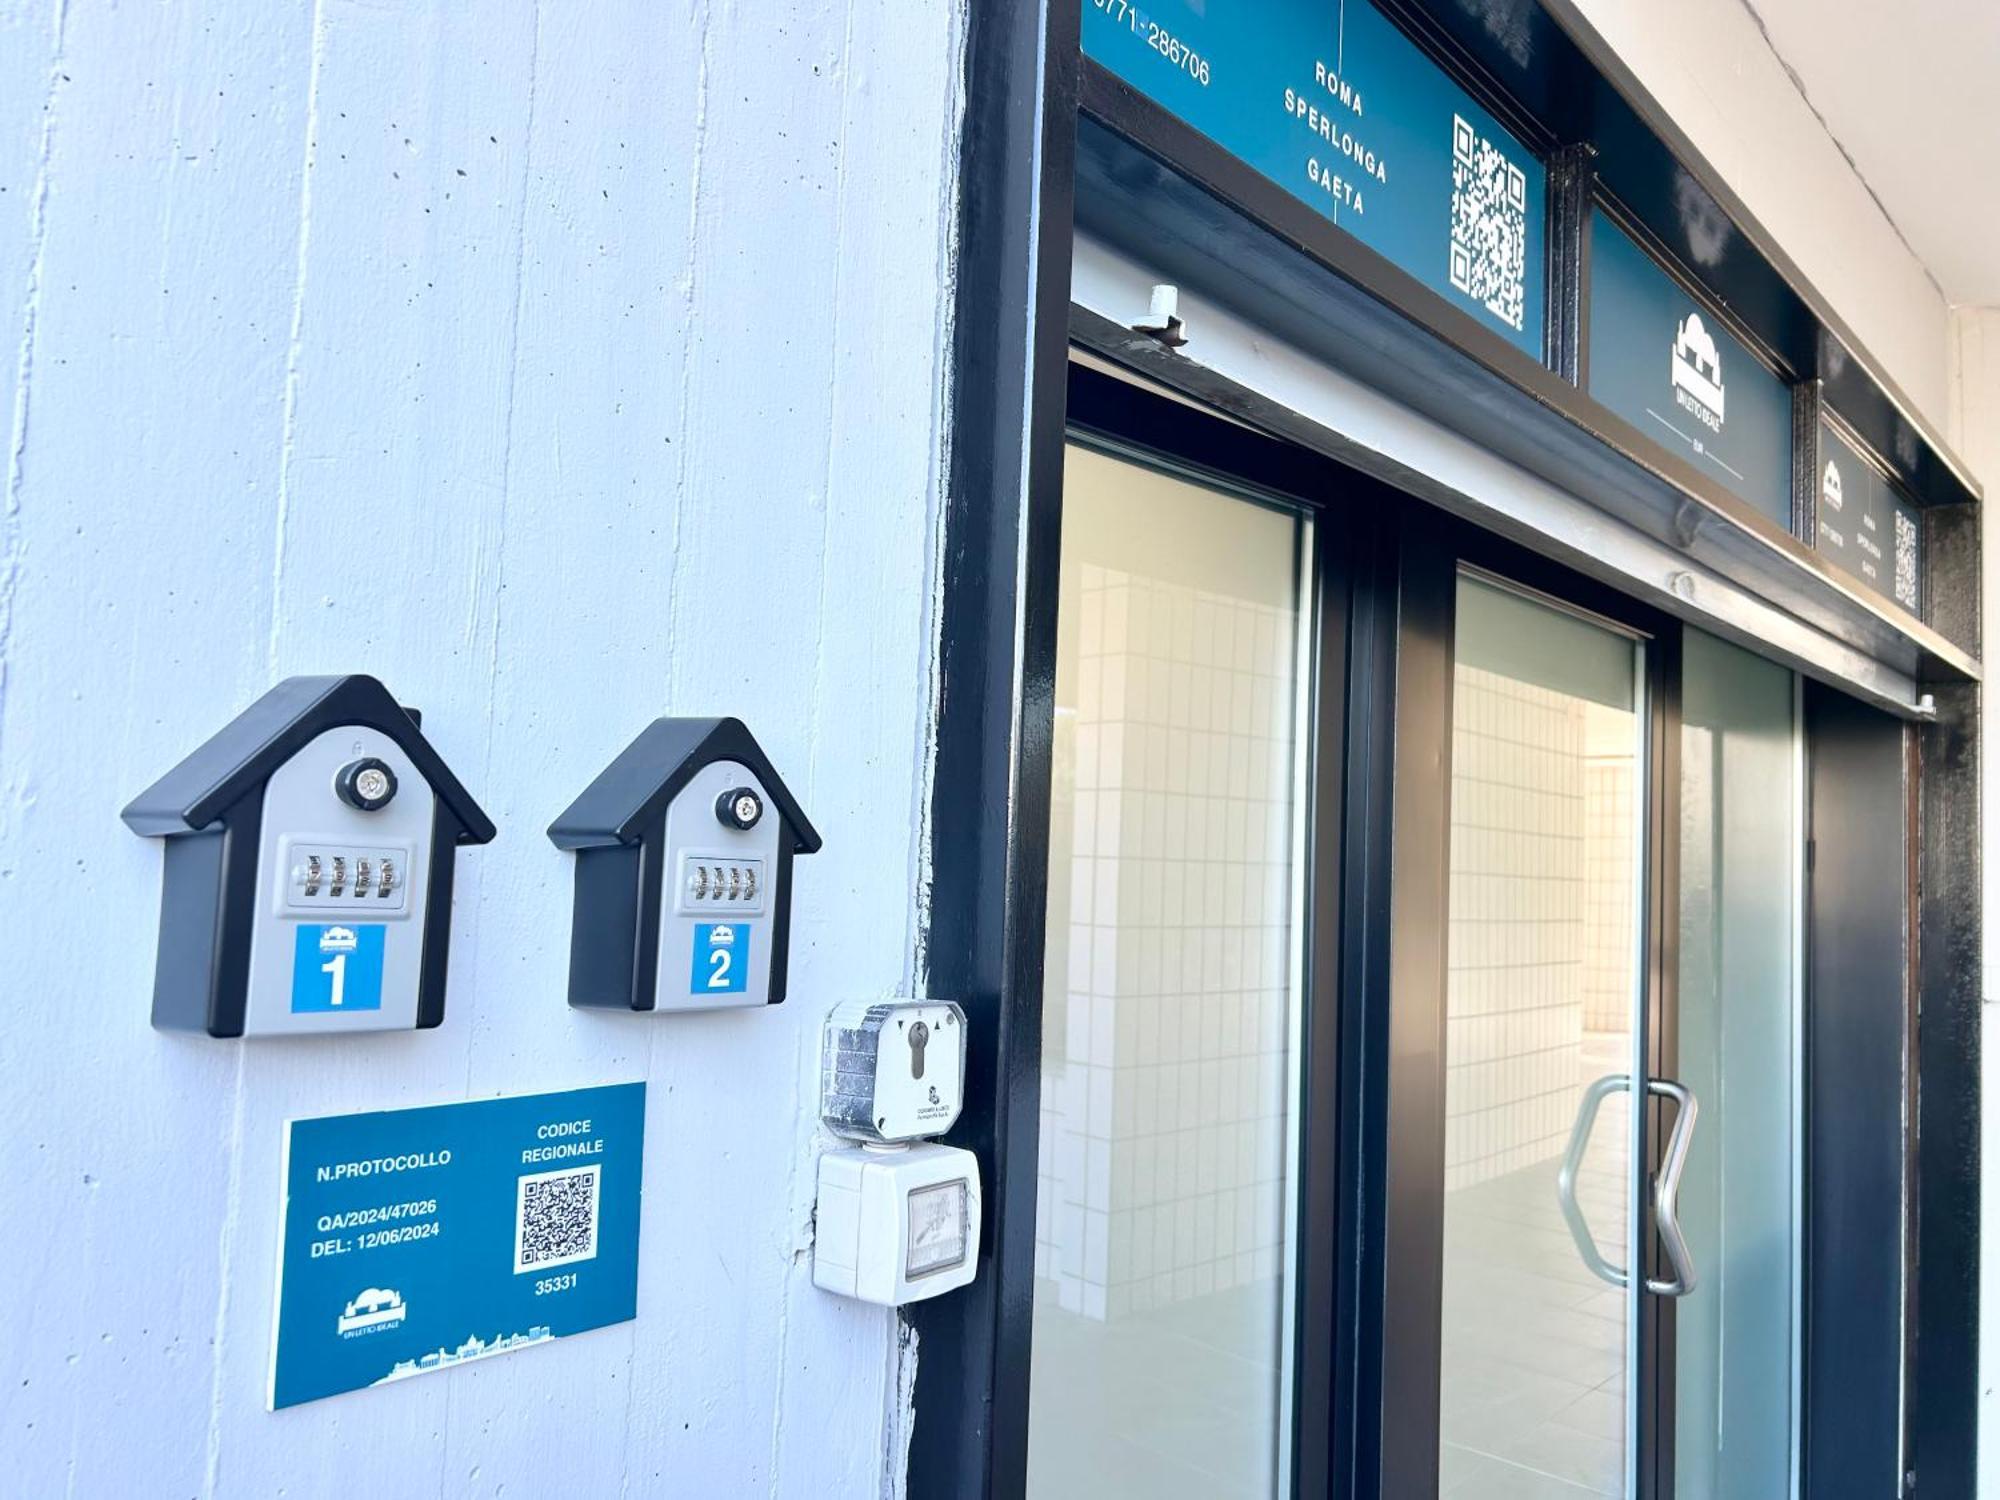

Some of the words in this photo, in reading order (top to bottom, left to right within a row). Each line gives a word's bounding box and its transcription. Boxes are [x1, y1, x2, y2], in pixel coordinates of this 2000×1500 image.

[1315, 61, 1363, 116] ROMA
[1284, 89, 1387, 183] SPERLONGA
[1307, 159, 1364, 214] GAETA
[321, 955, 346, 1005] 1
[708, 948, 731, 988] 2
[537, 1119, 592, 1139] CODICE
[316, 1150, 452, 1182] N.PROTOCOLLO
[521, 1140, 604, 1163] REGIONALE
[317, 1199, 437, 1231] QA/2024/47026
[310, 1237, 352, 1258] DEL:
[357, 1223, 440, 1249] 12/06/2024
[534, 1274, 578, 1296] 35331
